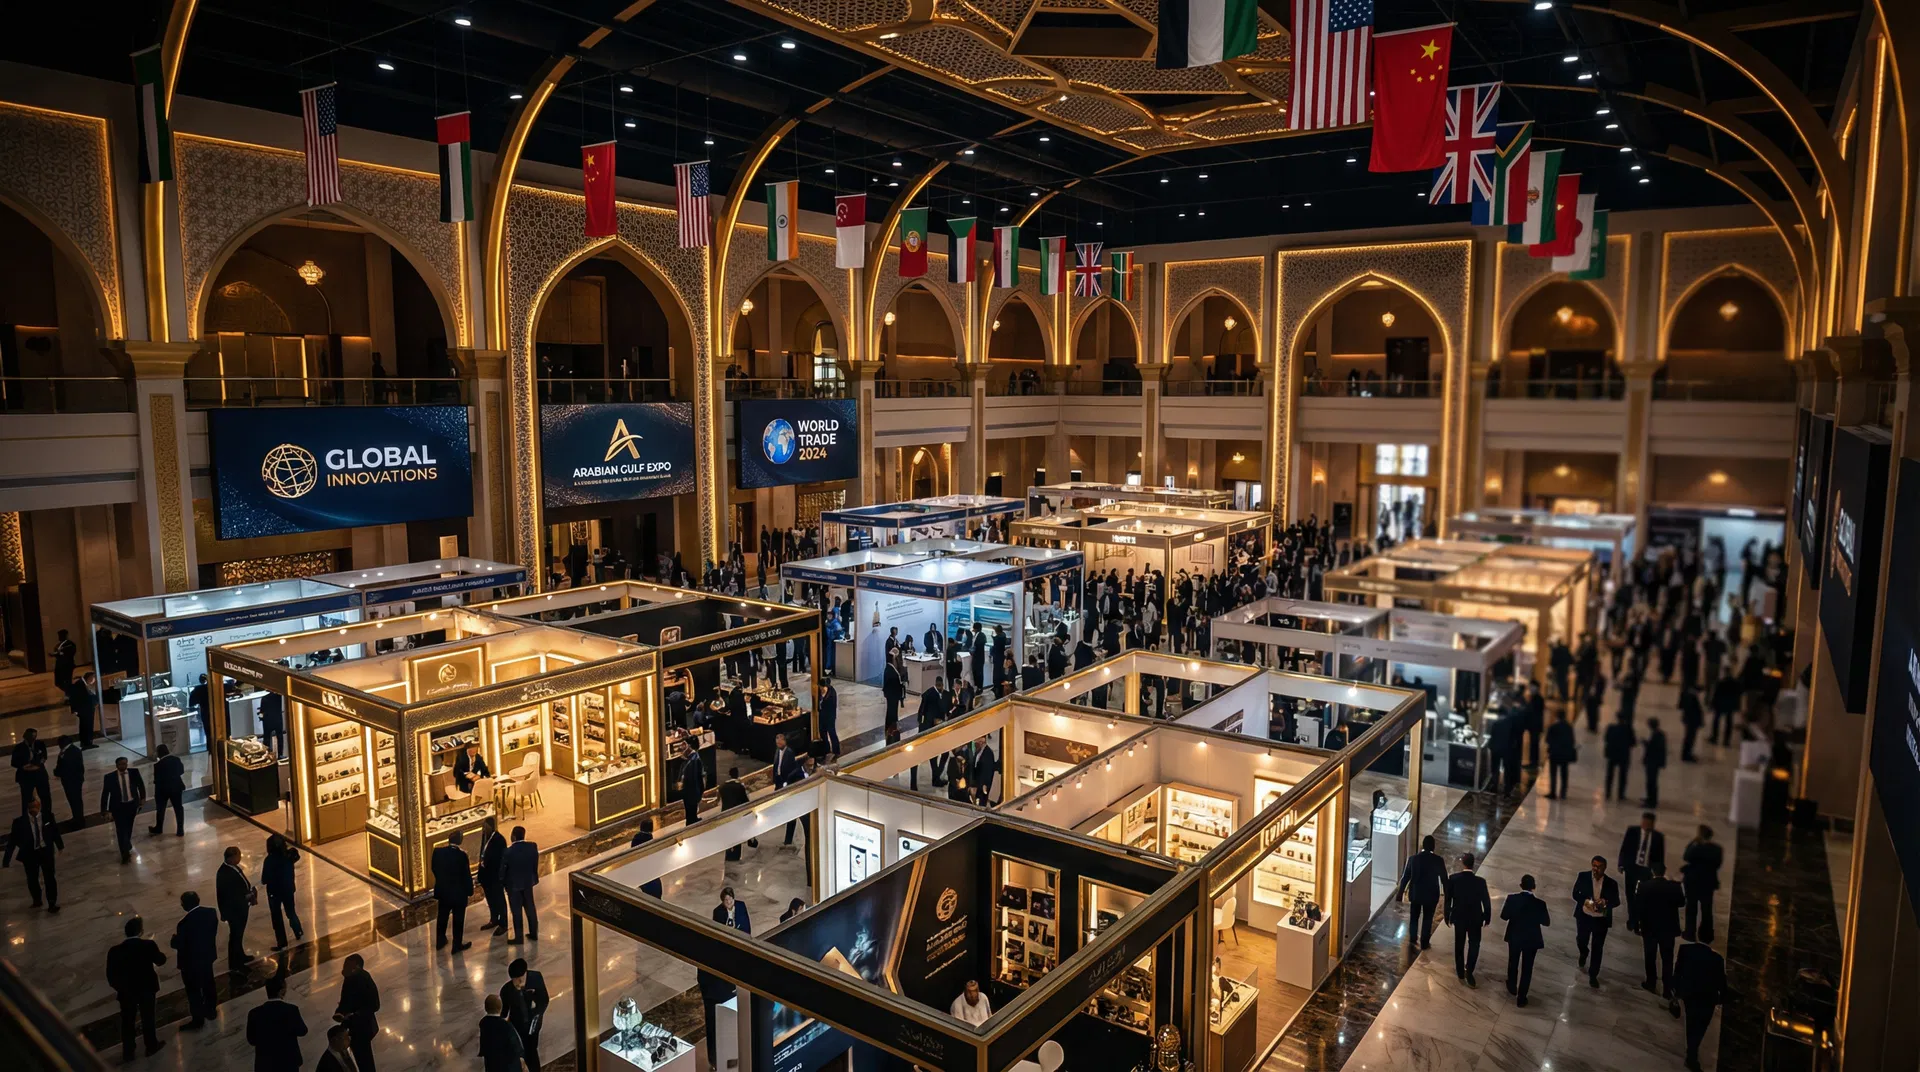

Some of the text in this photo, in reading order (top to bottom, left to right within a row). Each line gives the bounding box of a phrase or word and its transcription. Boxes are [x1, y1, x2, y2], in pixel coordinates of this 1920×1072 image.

[798, 419, 839, 432] WORLD
[798, 433, 837, 446] TRADE
[325, 445, 437, 470] GLOBAL
[799, 447, 828, 460] 2024
[326, 467, 438, 487] INNOVATIONS
[573, 461, 672, 478] ARABIAN GULF EXPO
